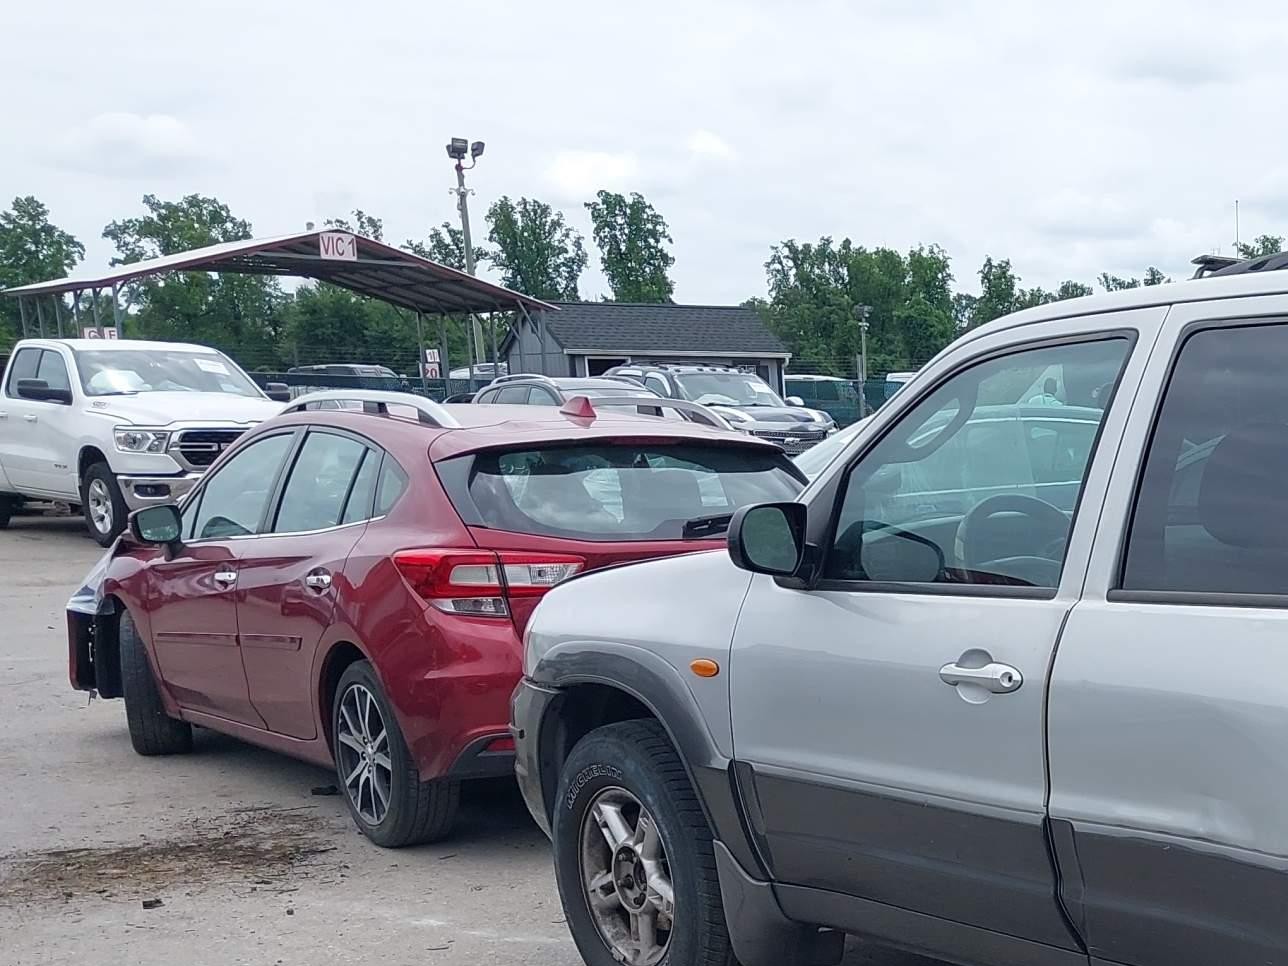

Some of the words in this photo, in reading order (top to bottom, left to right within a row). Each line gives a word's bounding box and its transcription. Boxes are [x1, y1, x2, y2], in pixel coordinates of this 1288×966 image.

[321, 235, 345, 257] VIC
[347, 237, 356, 257] 1
[566, 764, 623, 809] MICHELIN
